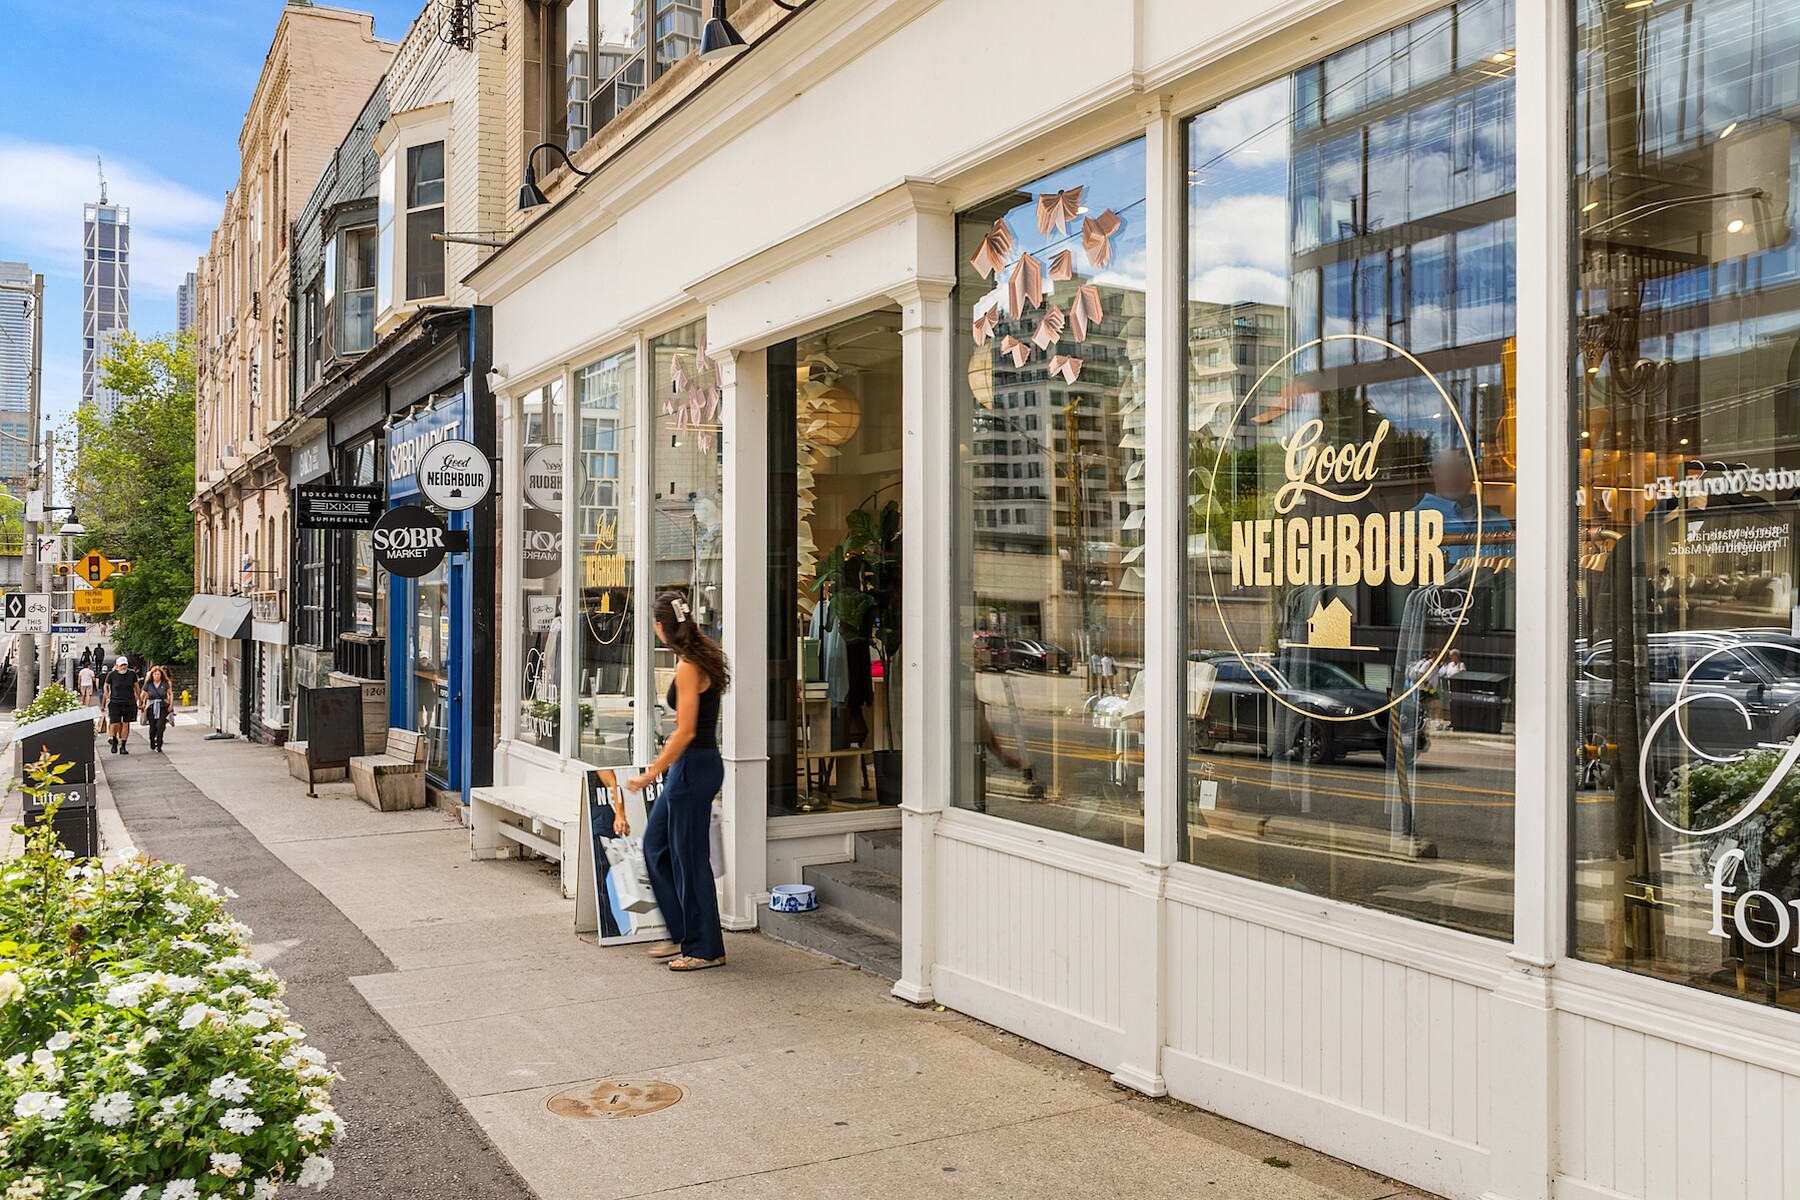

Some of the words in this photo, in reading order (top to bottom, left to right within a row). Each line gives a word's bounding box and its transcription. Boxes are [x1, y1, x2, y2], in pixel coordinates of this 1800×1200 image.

[390, 439, 416, 481] SØBR
[440, 454, 472, 472] Good
[1273, 418, 1390, 515] Good
[427, 471, 484, 488] NEIGHBOUR
[310, 516, 369, 524] SUMMERHILL
[594, 513, 617, 554] Good
[374, 527, 446, 551] SØBR
[1231, 509, 1445, 587] NEIGHBOUR
[386, 548, 429, 560] MARKET
[586, 553, 626, 588] NEIGHBOUR
